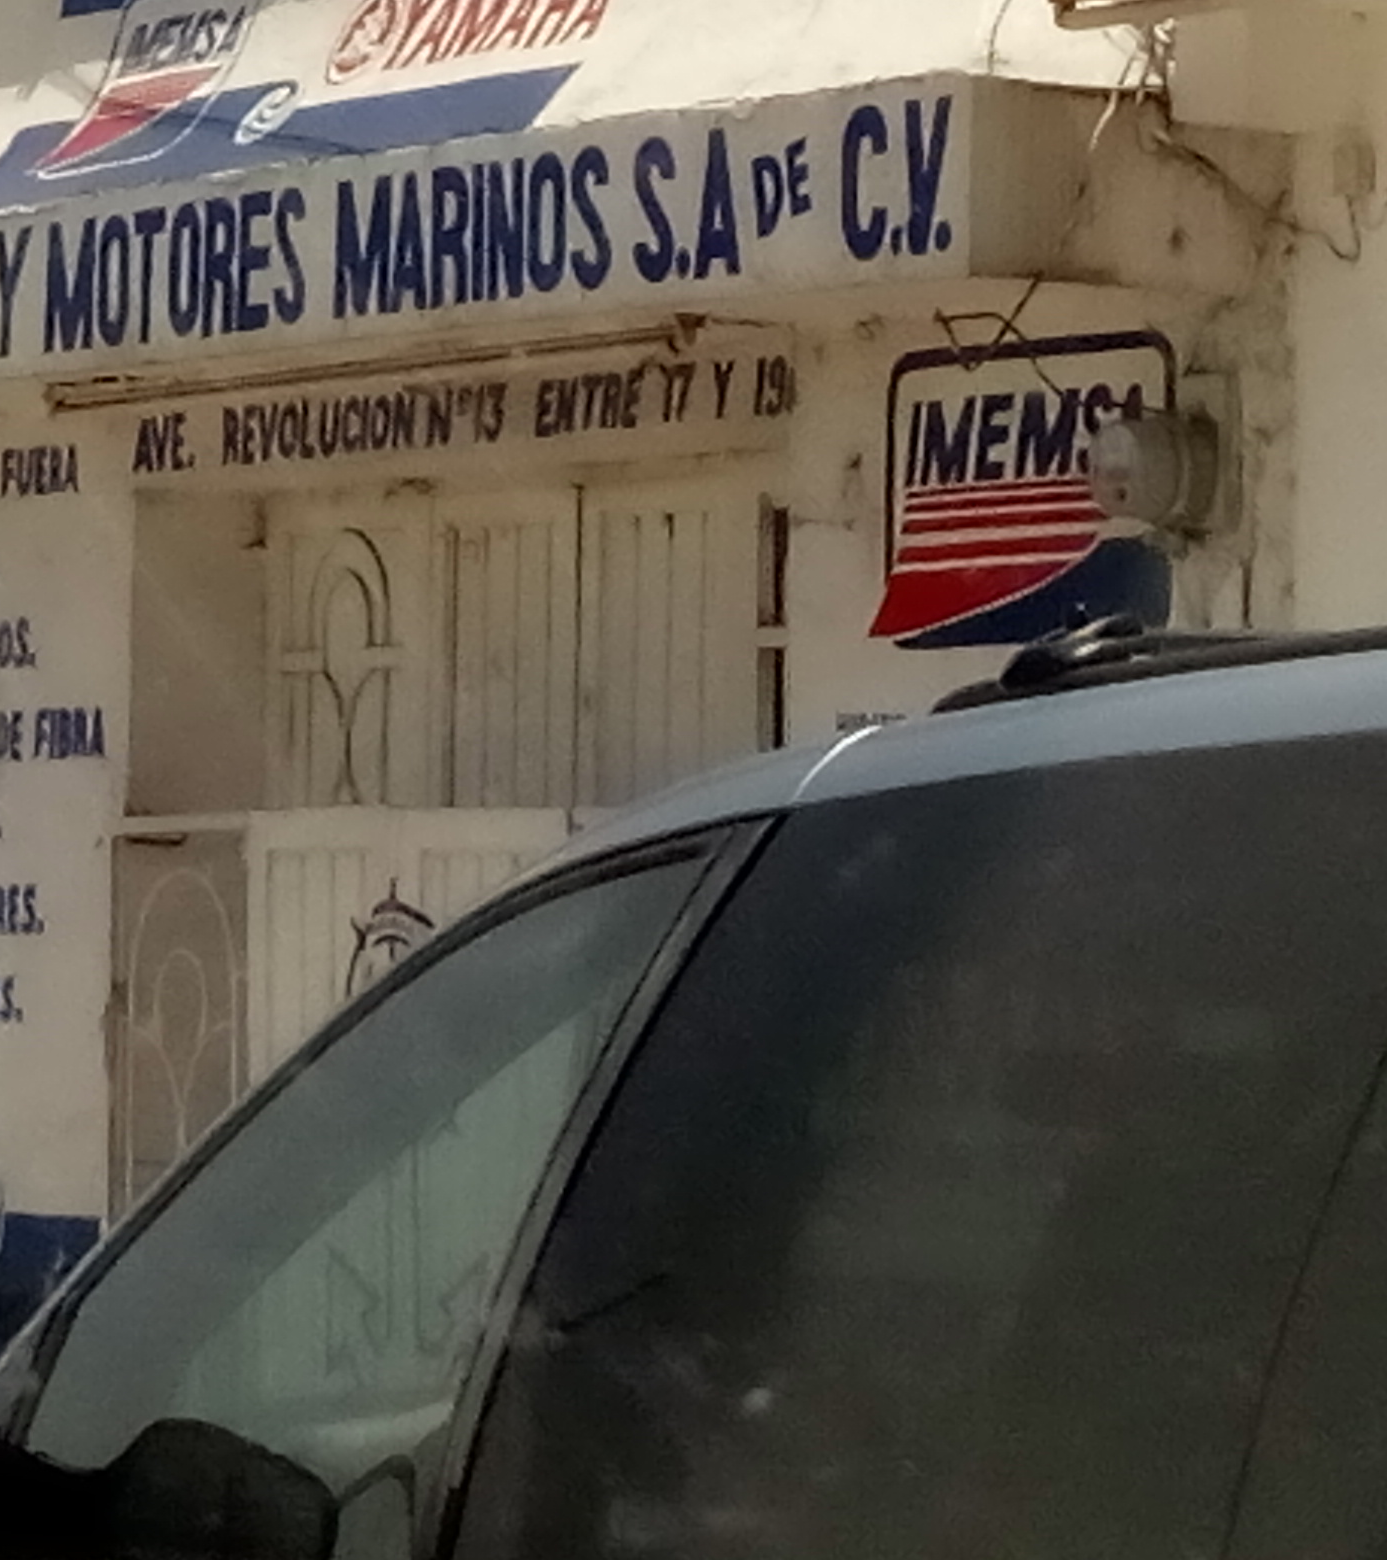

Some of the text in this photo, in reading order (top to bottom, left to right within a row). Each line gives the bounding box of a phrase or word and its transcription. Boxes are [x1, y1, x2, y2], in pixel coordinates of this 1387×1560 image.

[43, 187, 307, 354] MOTORES
[333, 145, 612, 318] MARINOS
[752, 137, 812, 238] DE
[841, 95, 953, 261] C.V.
[132, 410, 196, 472] AVE.
[222, 392, 414, 465] REVOLUCION
[535, 370, 642, 438] ENTRE
[713, 359, 735, 420] Y
[906, 383, 1143, 486] IMEMS
[1, 445, 78, 497] FUERA
